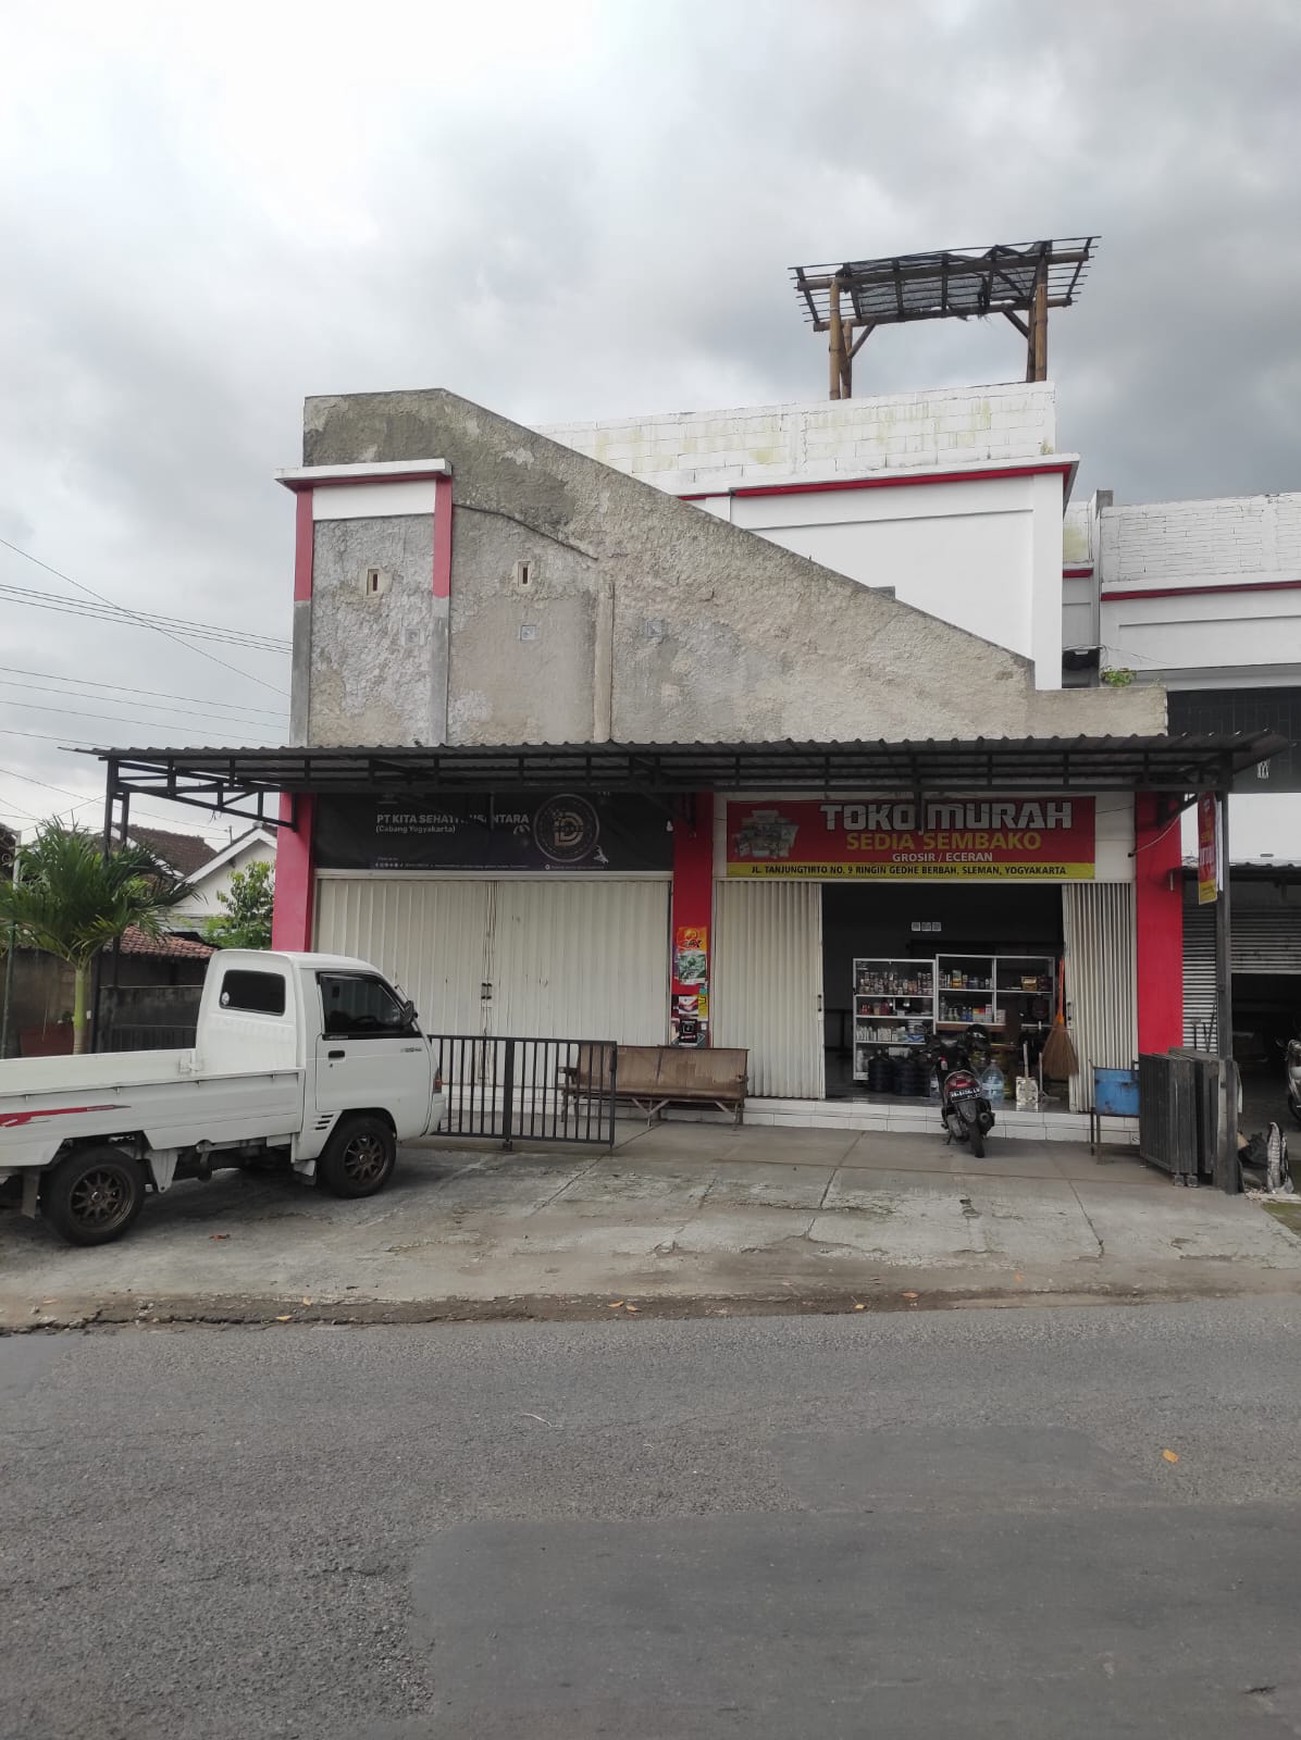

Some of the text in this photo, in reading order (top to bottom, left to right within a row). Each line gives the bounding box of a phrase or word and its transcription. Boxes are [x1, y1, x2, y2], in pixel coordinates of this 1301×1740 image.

[377, 814, 391, 824] PT
[392, 814, 417, 824] KITA
[820, 802, 1073, 831] TOKO MURAH
[846, 831, 1042, 850] SEDIA SEMBAKO
[892, 852, 936, 862] GROSIR
[945, 852, 993, 862] ECERAN
[856, 866, 886, 874] RINGIN
[889, 866, 918, 874] GEDHE
[962, 866, 1002, 875] SLEMAN,
[1005, 866, 1067, 875] YOGYAKARTA
